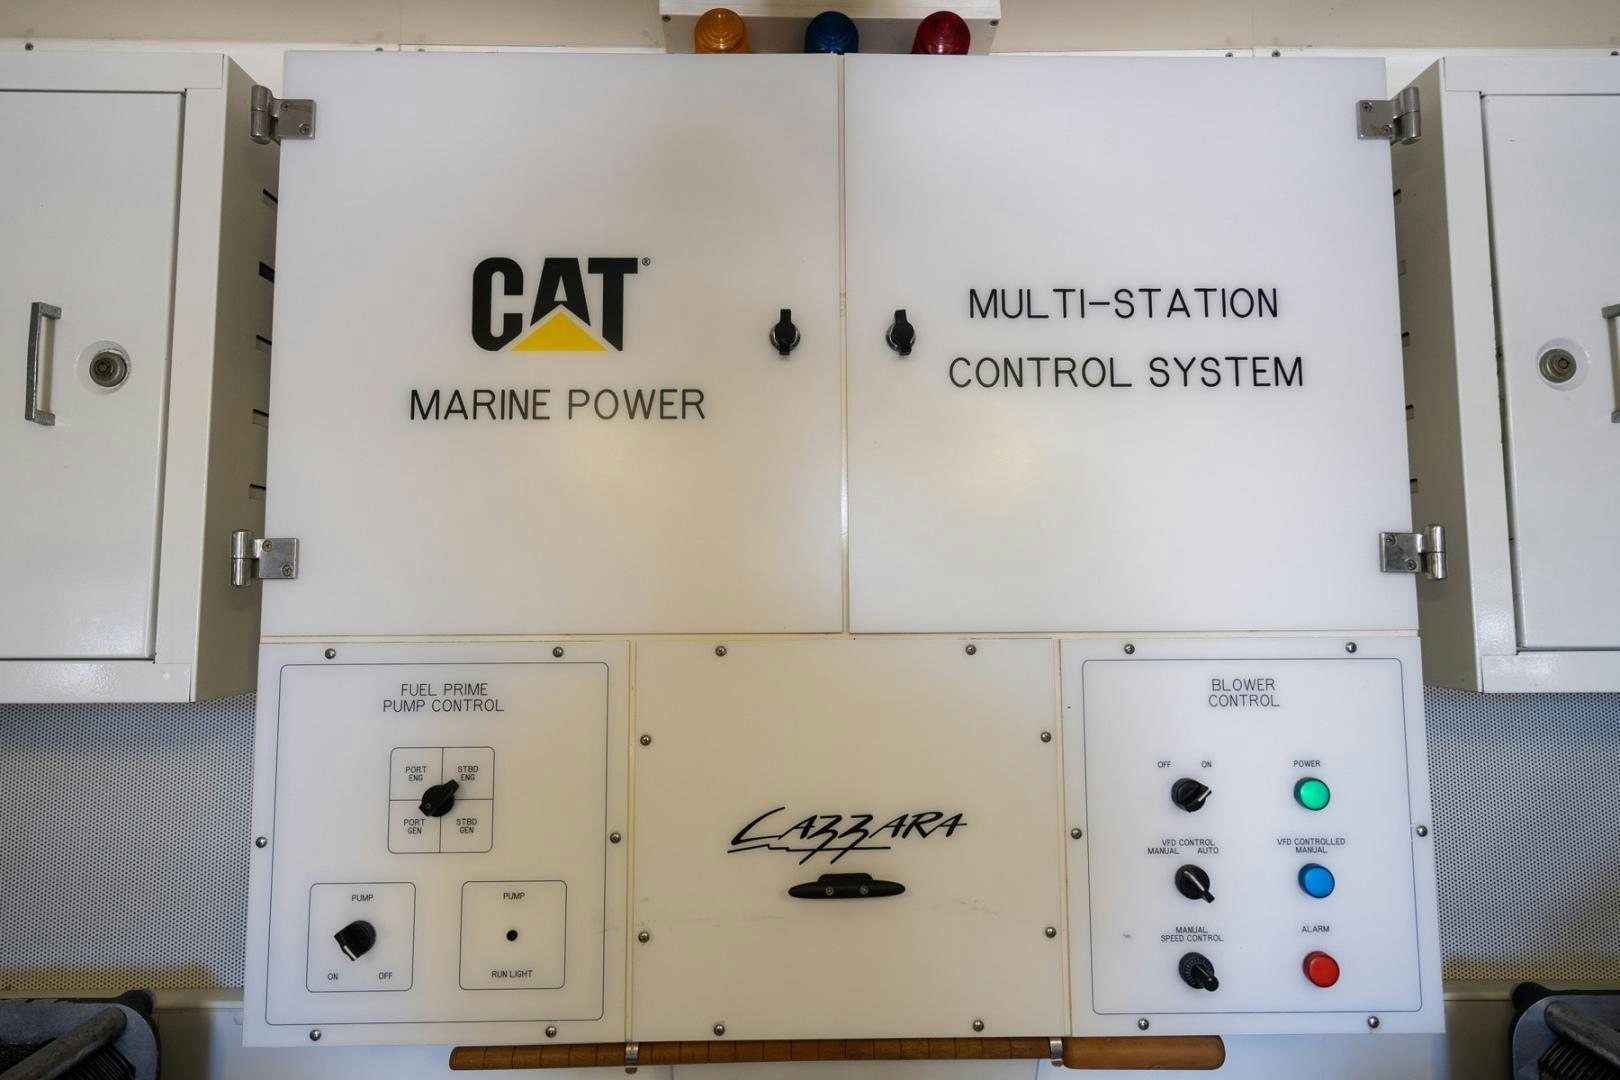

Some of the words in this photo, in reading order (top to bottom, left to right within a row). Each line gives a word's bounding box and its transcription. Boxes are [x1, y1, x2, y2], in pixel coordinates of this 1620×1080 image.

[969, 288, 1279, 318] MULTI-STATION
[949, 356, 1132, 387] CONTROL
[1149, 356, 1304, 387] SYSTEM
[409, 389, 551, 420] MARINE
[567, 389, 706, 420] POWER
[1211, 679, 1276, 692] BLOWER
[400, 683, 437, 697] FUEL
[443, 683, 489, 697] PRIME
[1208, 694, 1281, 708] CONTROL
[383, 699, 426, 713] PUMP
[431, 699, 505, 713] CONTROL
[1293, 760, 1321, 768] POWER
[457, 765, 479, 773] STBD
[408, 774, 424, 782] ENG
[460, 773, 475, 781] ENG
[456, 818, 478, 826] STBD
[407, 826, 422, 834] GEN
[459, 826, 474, 834] GEN
[1162, 838, 1177, 847] VFD
[1178, 838, 1216, 847] CONTROL
[1277, 838, 1292, 846] VFD
[1294, 838, 1346, 846] CONTROLLED
[1147, 847, 1180, 855] MANUAL
[1197, 847, 1219, 855] AUTO
[1295, 846, 1328, 854] MANUAL
[351, 894, 374, 902] PUMP
[503, 892, 525, 900] PUMP
[1175, 926, 1208, 934] MANUAL
[1301, 925, 1330, 933] ALARM
[1160, 934, 1185, 942] SPEED
[1186, 934, 1224, 942] CONTROL
[327, 972, 339, 981] ON
[378, 972, 393, 980] OFF
[491, 970, 509, 978] RUN
[509, 970, 533, 978] LIGHT
